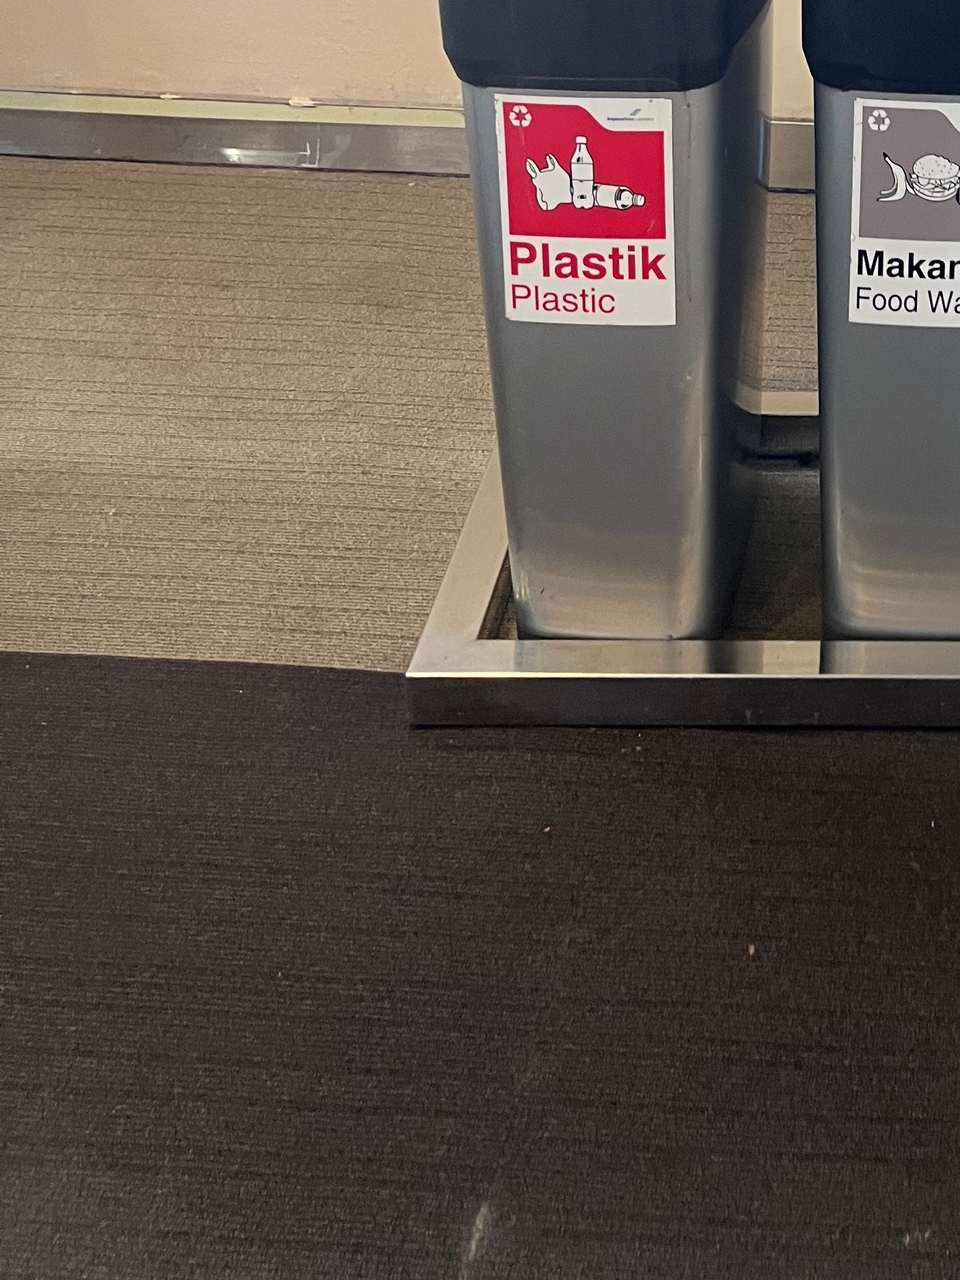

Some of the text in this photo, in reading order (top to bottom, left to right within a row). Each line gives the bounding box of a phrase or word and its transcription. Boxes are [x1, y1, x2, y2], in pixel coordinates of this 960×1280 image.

[509, 241, 667, 280] Plastik
[511, 284, 616, 314] Plastic
[856, 287, 918, 313] Food
